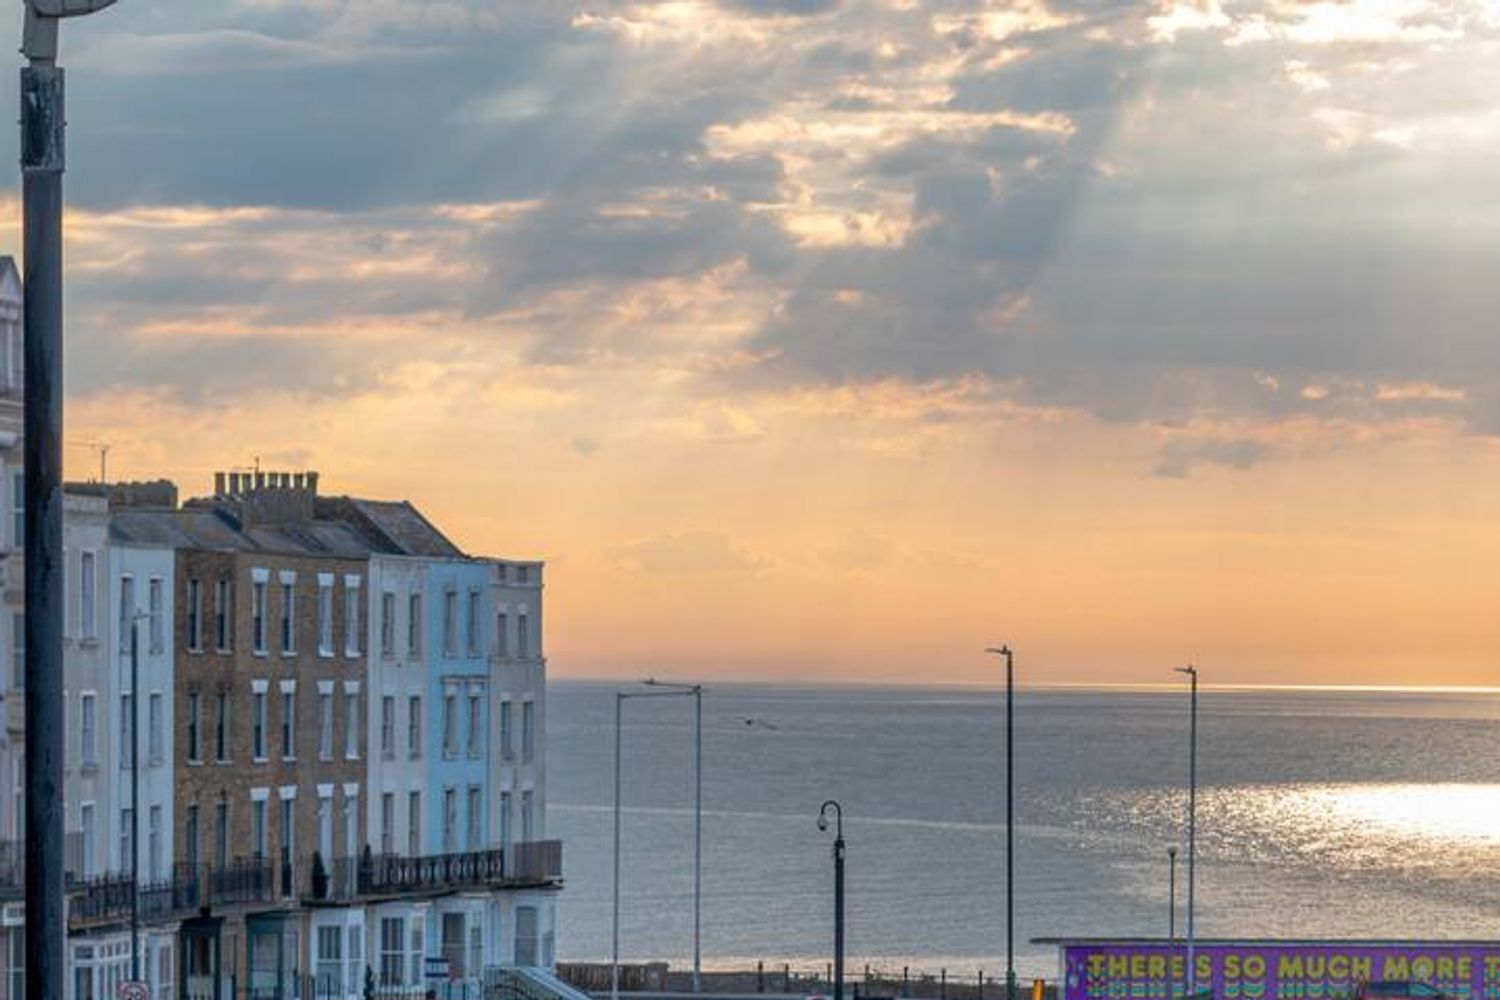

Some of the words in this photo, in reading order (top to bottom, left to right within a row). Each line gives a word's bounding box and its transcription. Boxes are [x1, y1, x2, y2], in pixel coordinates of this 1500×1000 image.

[1224, 955, 1266, 978] SO
[1279, 955, 1371, 979] MUCH
[1384, 956, 1472, 980] MORE
